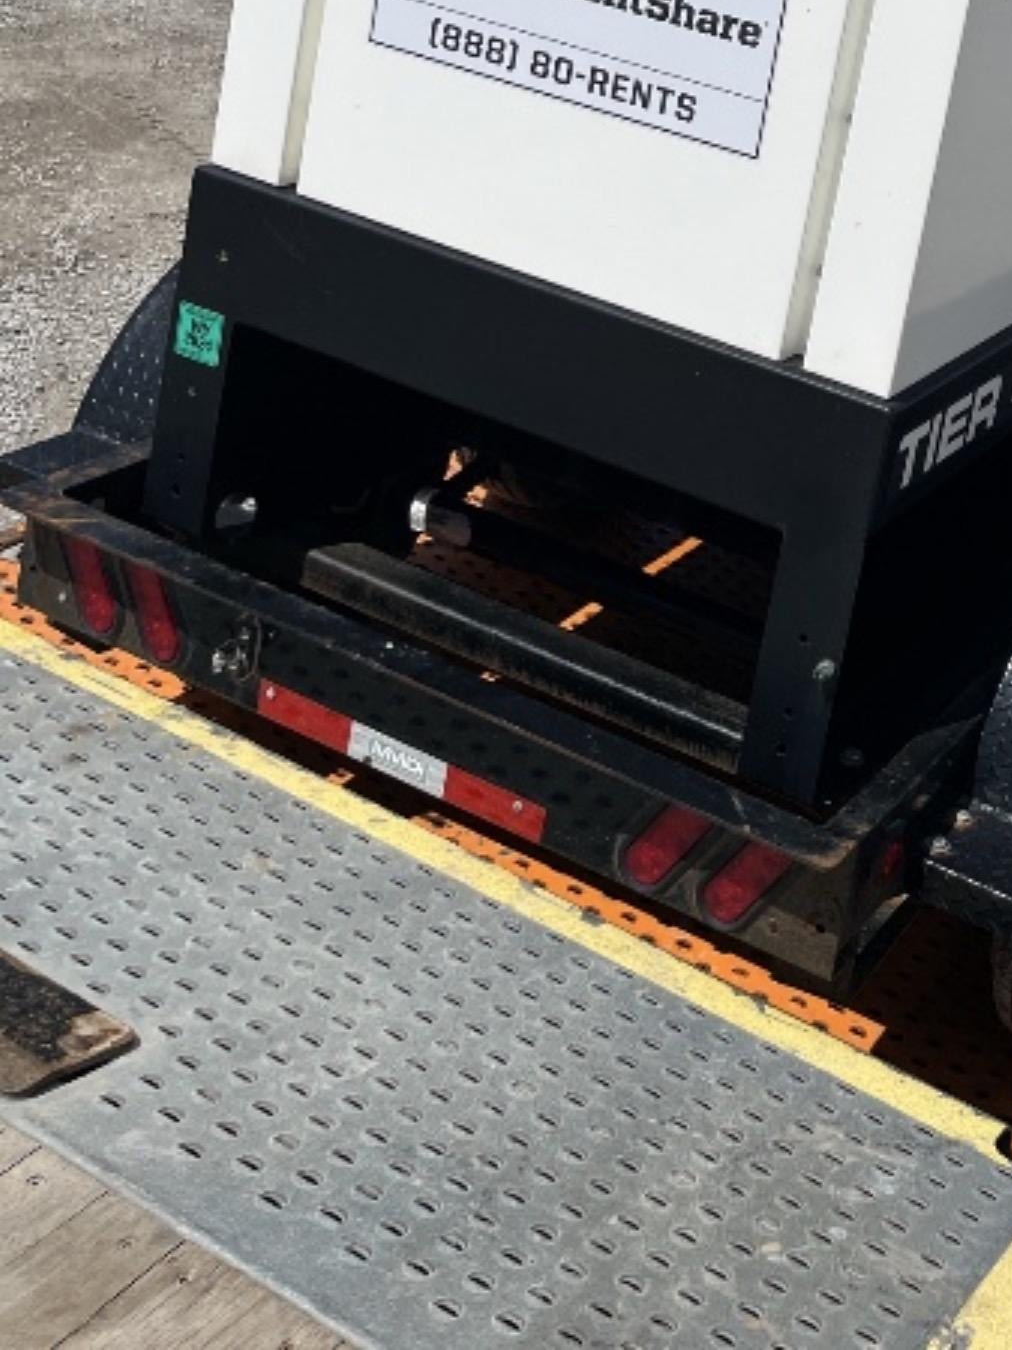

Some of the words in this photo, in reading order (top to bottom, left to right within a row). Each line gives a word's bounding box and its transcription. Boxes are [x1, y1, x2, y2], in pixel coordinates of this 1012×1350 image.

[429, 17, 519, 71] (888)
[529, 50, 698, 123] 80-RENTS
[899, 376, 1003, 488] TIER
